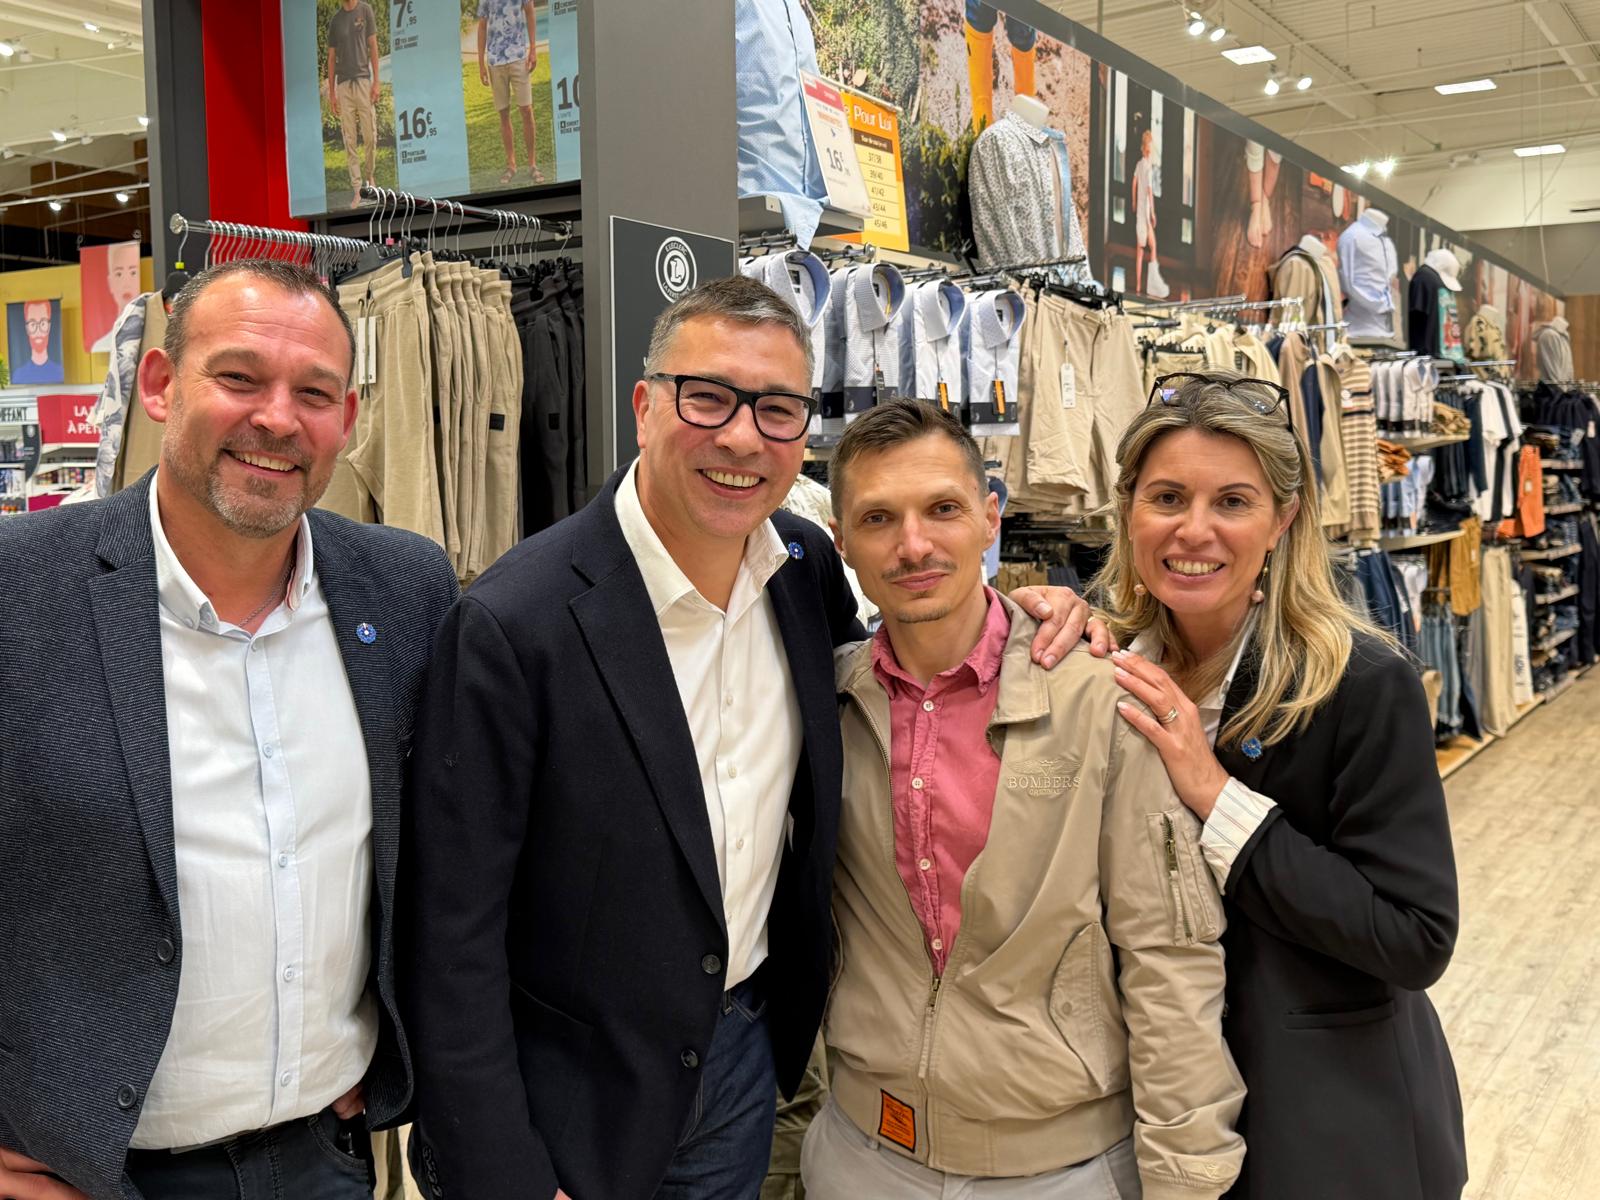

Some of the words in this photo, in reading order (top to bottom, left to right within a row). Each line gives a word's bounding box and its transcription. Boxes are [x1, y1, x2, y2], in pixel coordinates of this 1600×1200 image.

[853, 104, 876, 126] Pour
[878, 112, 893, 132] Lui
[74, 405, 89, 417] LA
[1007, 776, 1081, 789] BOMBERS
